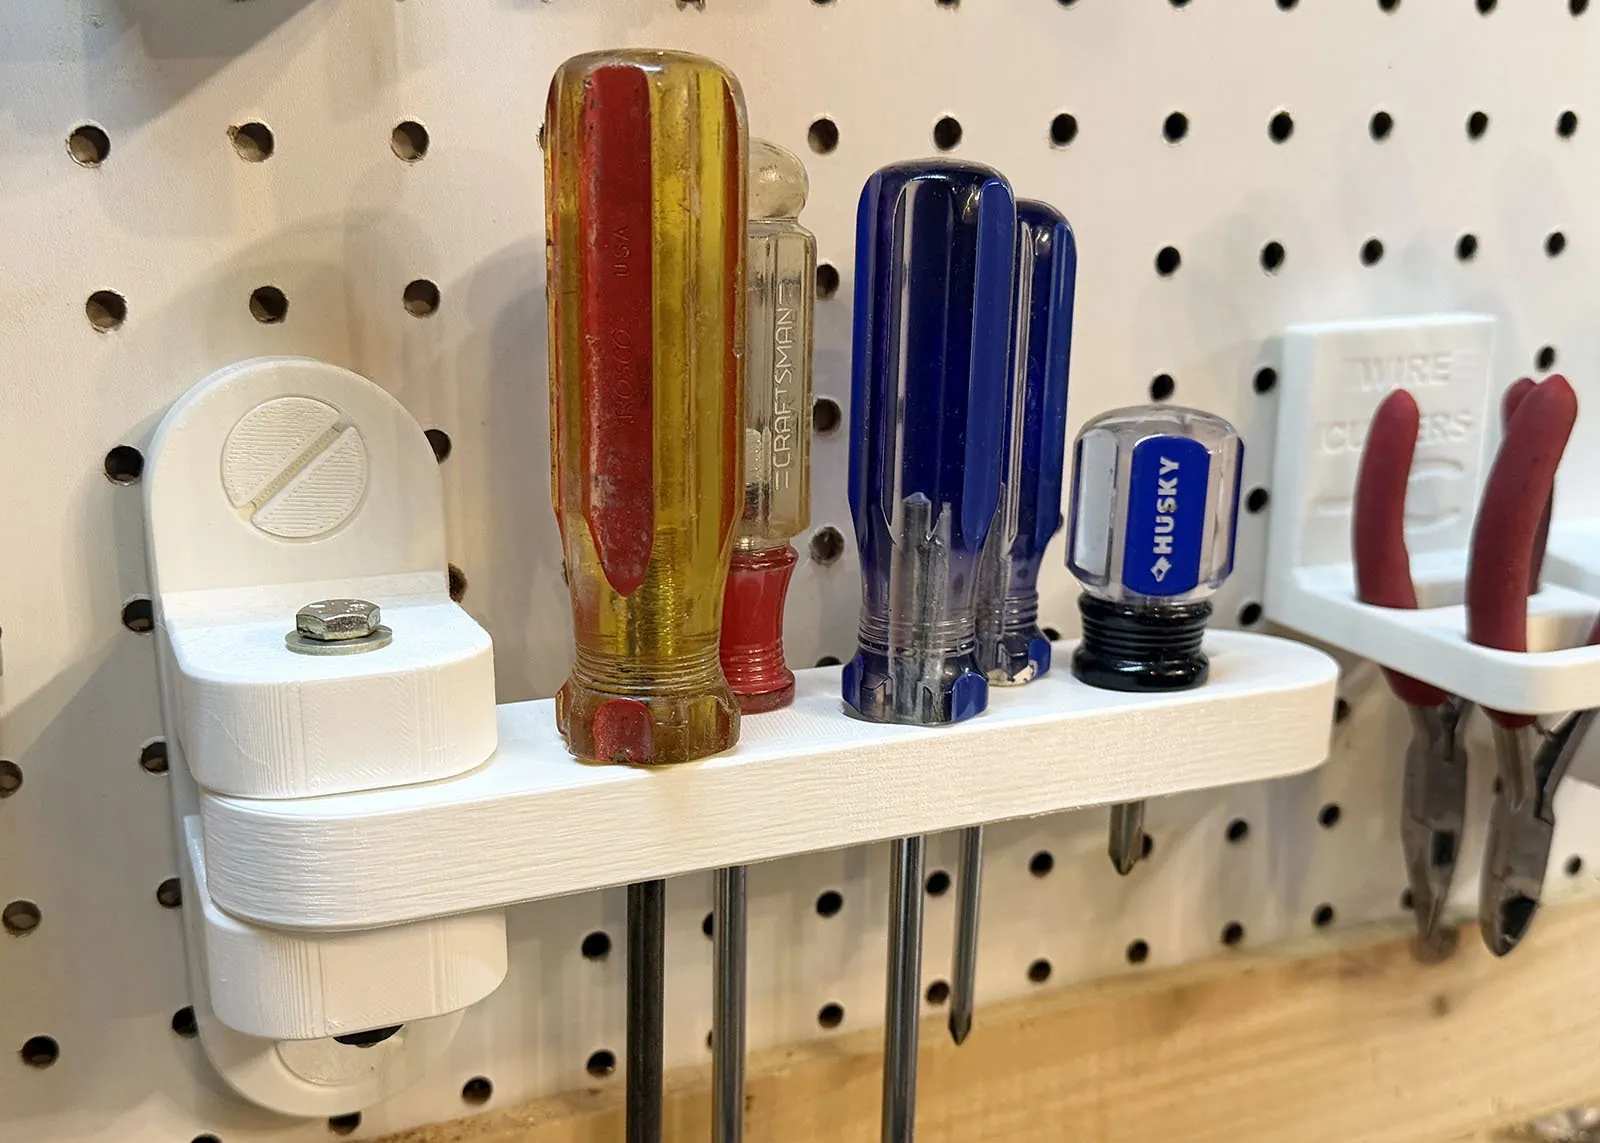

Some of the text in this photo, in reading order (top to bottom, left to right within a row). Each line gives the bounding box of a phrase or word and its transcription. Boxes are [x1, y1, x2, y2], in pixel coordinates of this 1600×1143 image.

[614, 226, 630, 277] USA
[774, 307, 793, 468] CRAFTSMAN
[1357, 352, 1453, 392] WIRE
[1320, 411, 1474, 455] CUERS
[1152, 455, 1180, 554] HUSKY
